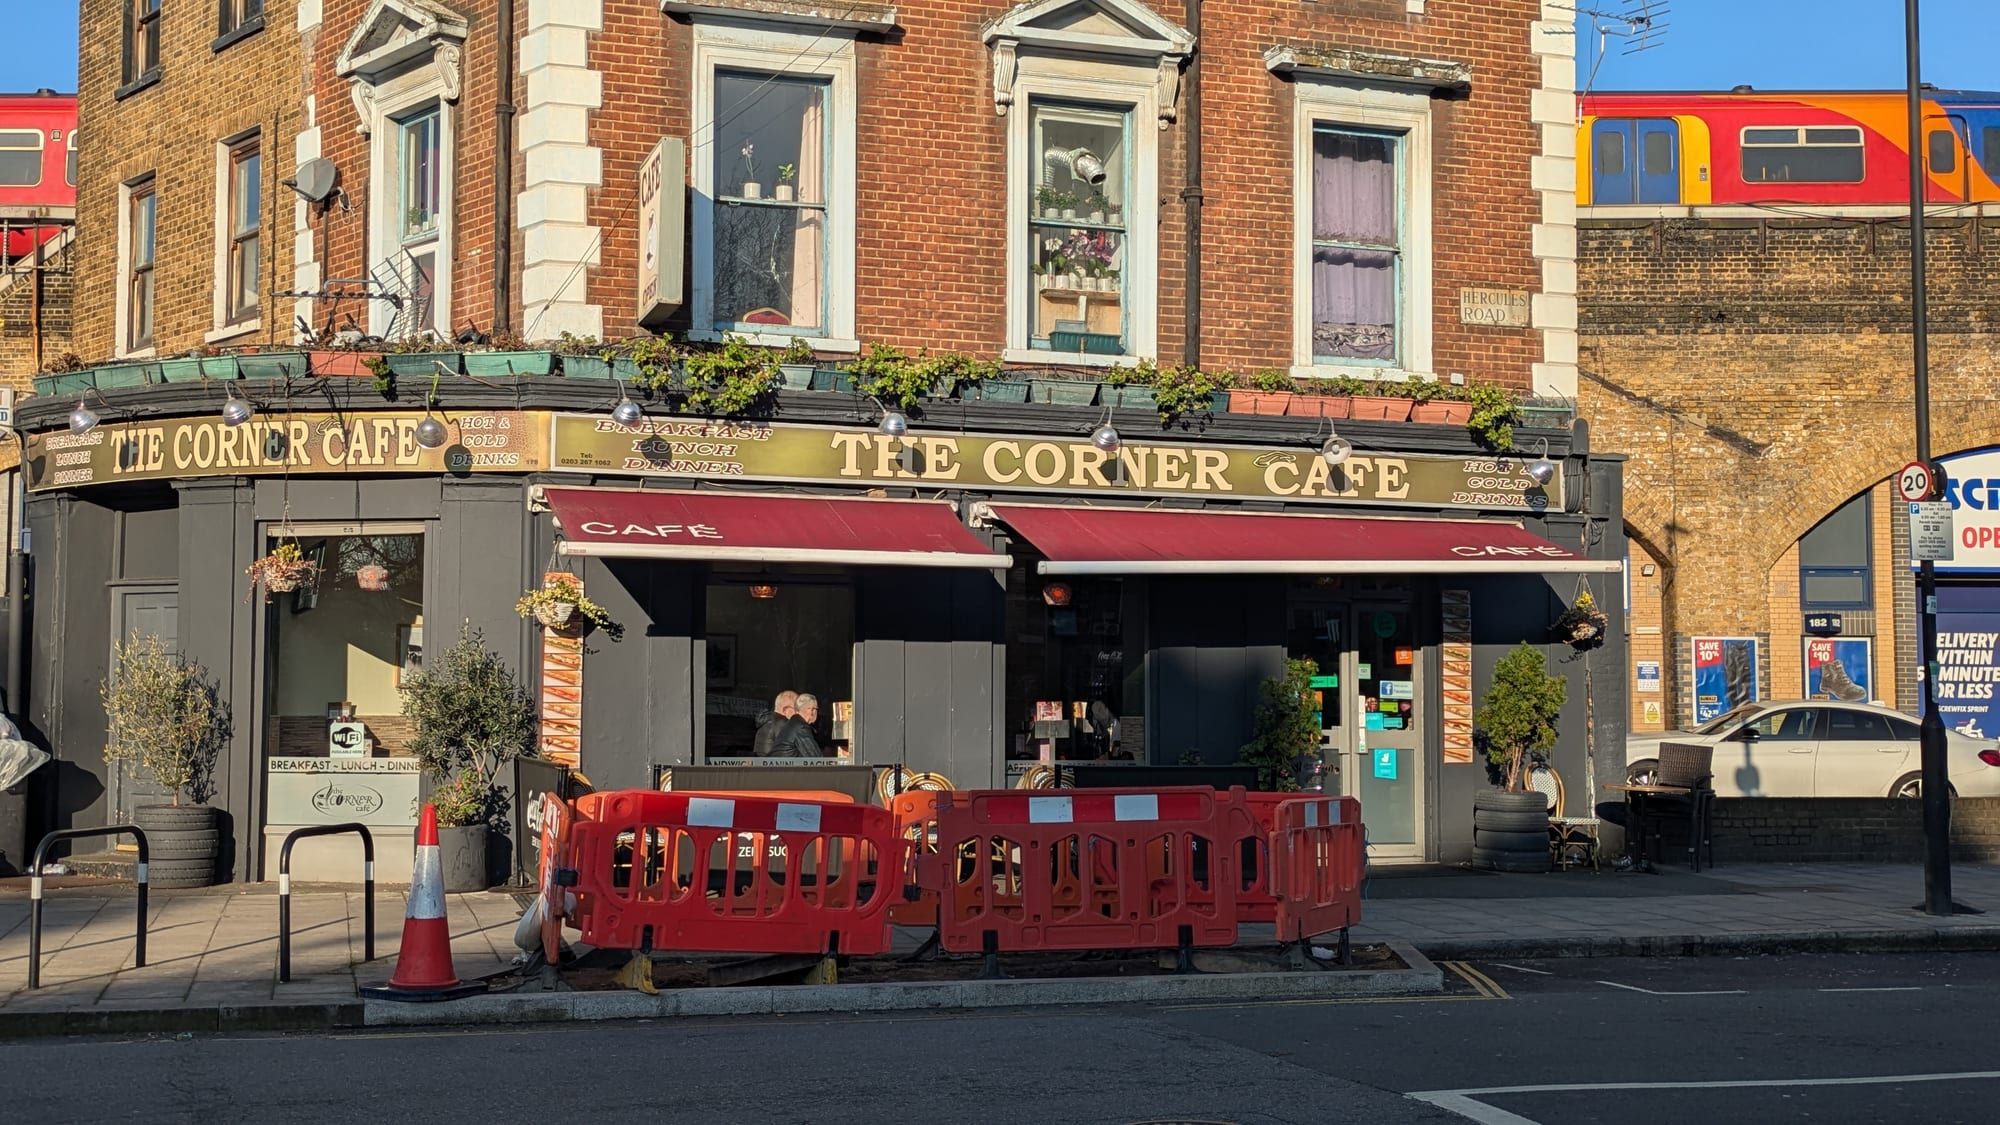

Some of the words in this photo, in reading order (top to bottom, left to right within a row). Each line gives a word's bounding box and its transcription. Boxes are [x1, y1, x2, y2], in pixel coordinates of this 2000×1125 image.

[641, 152, 661, 208] CAFE
[1463, 291, 1527, 307] HERCULES
[1464, 307, 1506, 322] ROAD
[461, 416, 495, 430] HOT
[499, 417, 511, 429] &
[595, 418, 774, 441] BREAKFAST
[46, 431, 104, 451] BREAKFAST
[110, 427, 165, 474] THE
[173, 420, 311, 470] CORNER
[322, 417, 421, 467] CAFE
[463, 434, 508, 448] COLD
[631, 439, 737, 456] LUNCH
[55, 450, 91, 467] LUNCH
[451, 453, 520, 467] DRINKS
[622, 457, 744, 475] DINNER
[830, 431, 962, 480] THE
[983, 439, 1233, 491] CORNER
[1263, 452, 1410, 500] CAFE
[1463, 460, 1513, 474] HOT
[53, 467, 93, 485] DINNER
[1467, 476, 1532, 491] COLD
[1903, 473, 1926, 491] 20
[1451, 491, 1548, 507] DRINKS
[1809, 619, 1827, 627] 182
[1699, 642, 1719, 650] SAVE
[1812, 643, 1831, 651] SAVE
[1936, 633, 1998, 648] ELIVERY
[1700, 650, 1719, 661] 10%
[1813, 651, 1830, 662] £10
[1957, 683, 1993, 699] LESS
[271, 760, 331, 770] BREAKFAST
[341, 761, 377, 770] LUNCH
[388, 762, 420, 771] DINNE
[330, 794, 376, 806] CORNER
